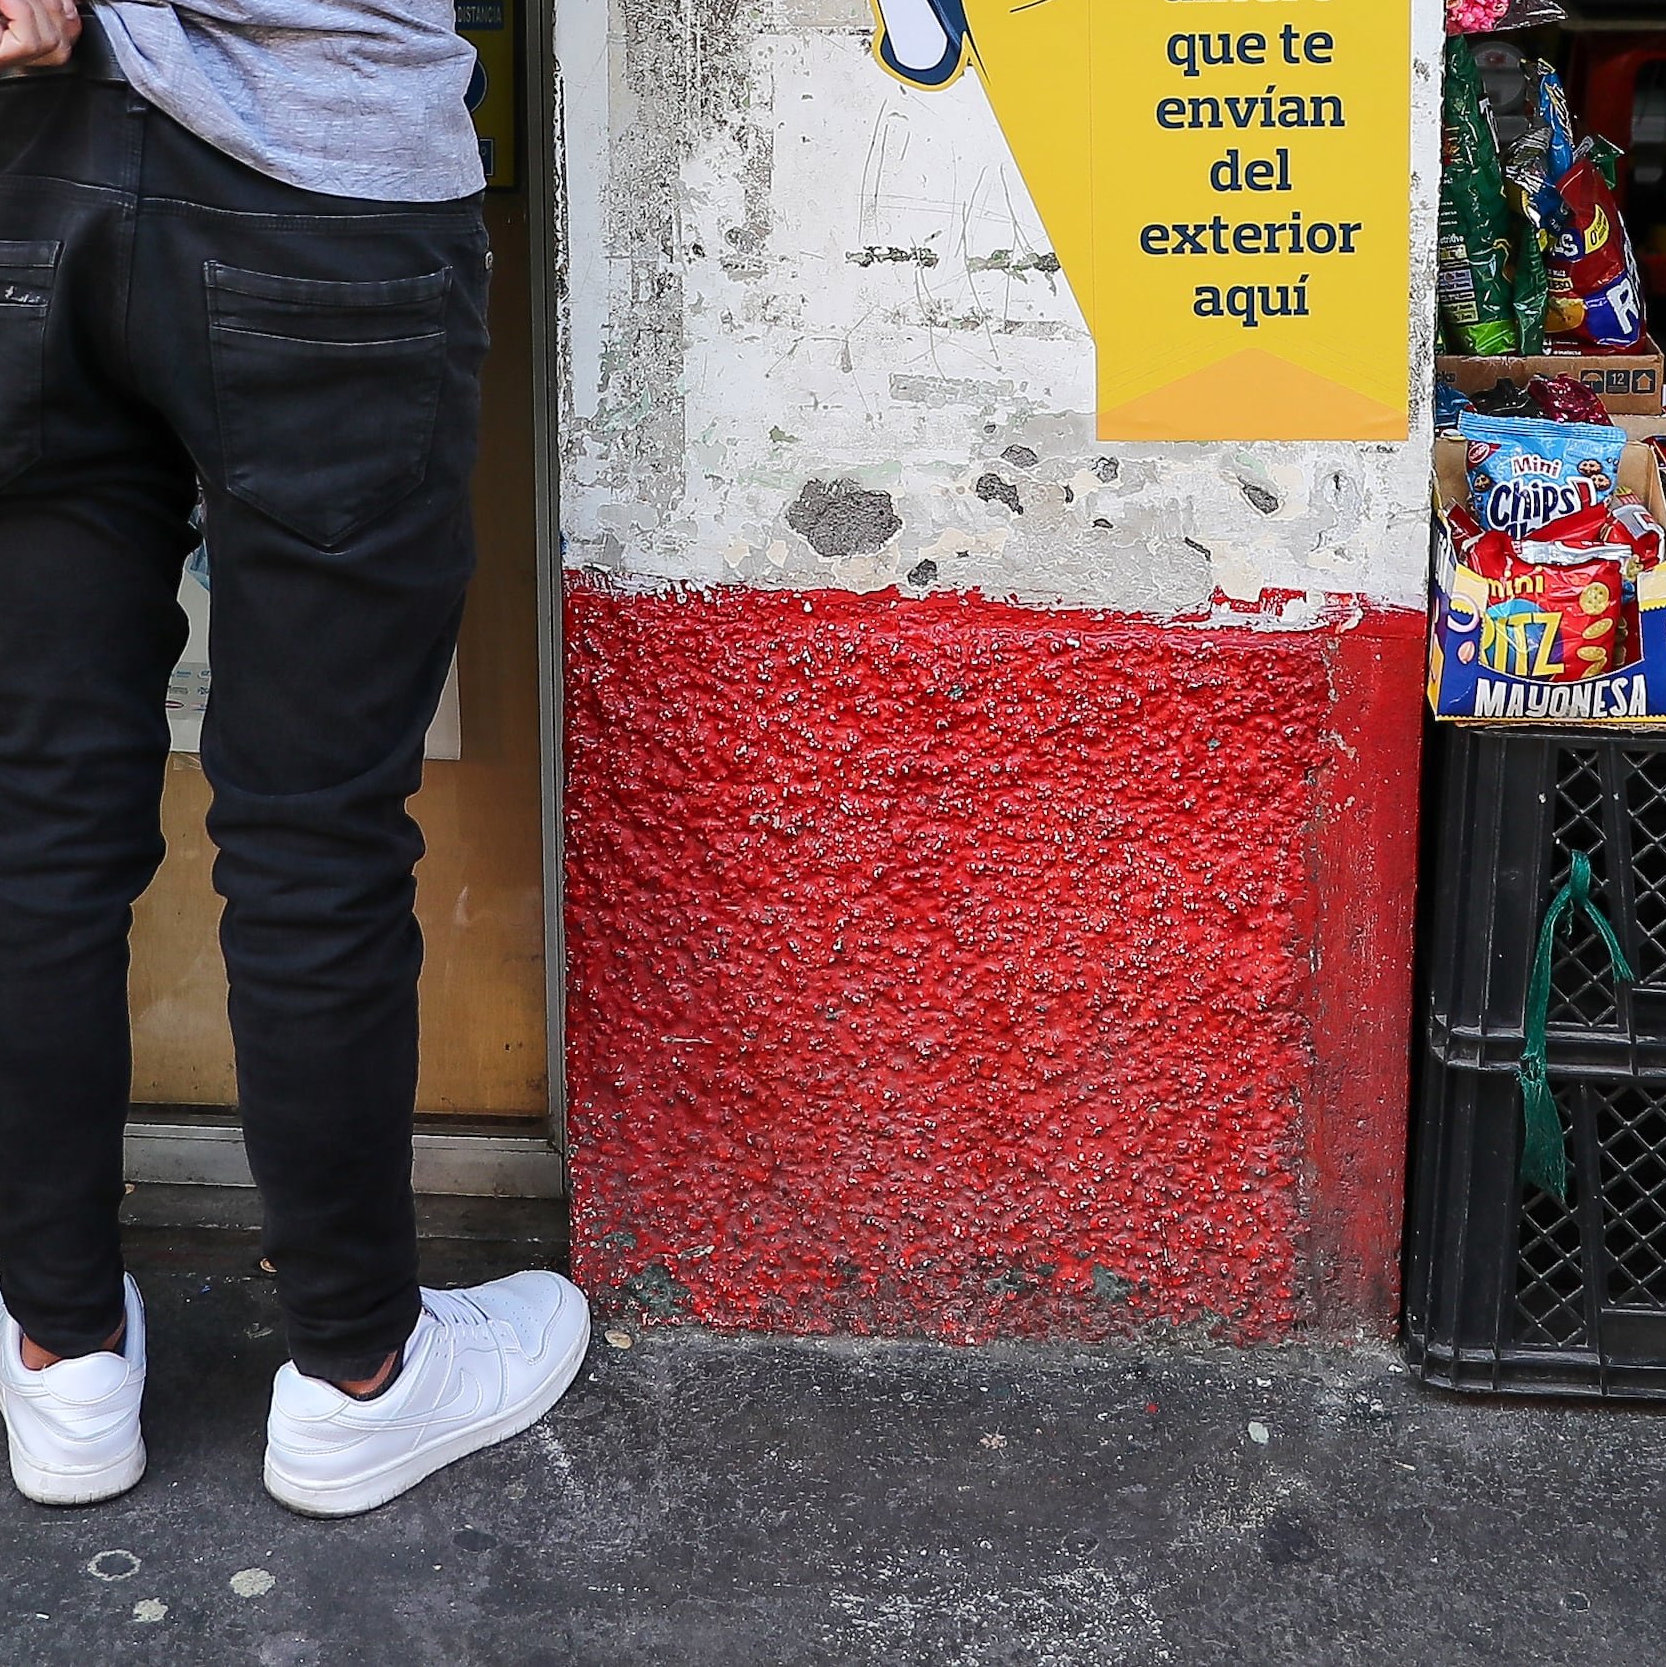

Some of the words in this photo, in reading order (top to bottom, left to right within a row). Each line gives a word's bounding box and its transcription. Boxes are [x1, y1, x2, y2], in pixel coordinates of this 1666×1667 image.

[1166, 28, 1267, 78] que
[1281, 25, 1334, 65] te
[1155, 84, 1346, 128] envían
[1209, 148, 1292, 192] del
[1139, 212, 1362, 256] exterior
[1192, 273, 1311, 328] aquí
[1512, 454, 1562, 478] Mini
[1489, 479, 1575, 527] Chips
[1474, 674, 1646, 718] MAYONESA
